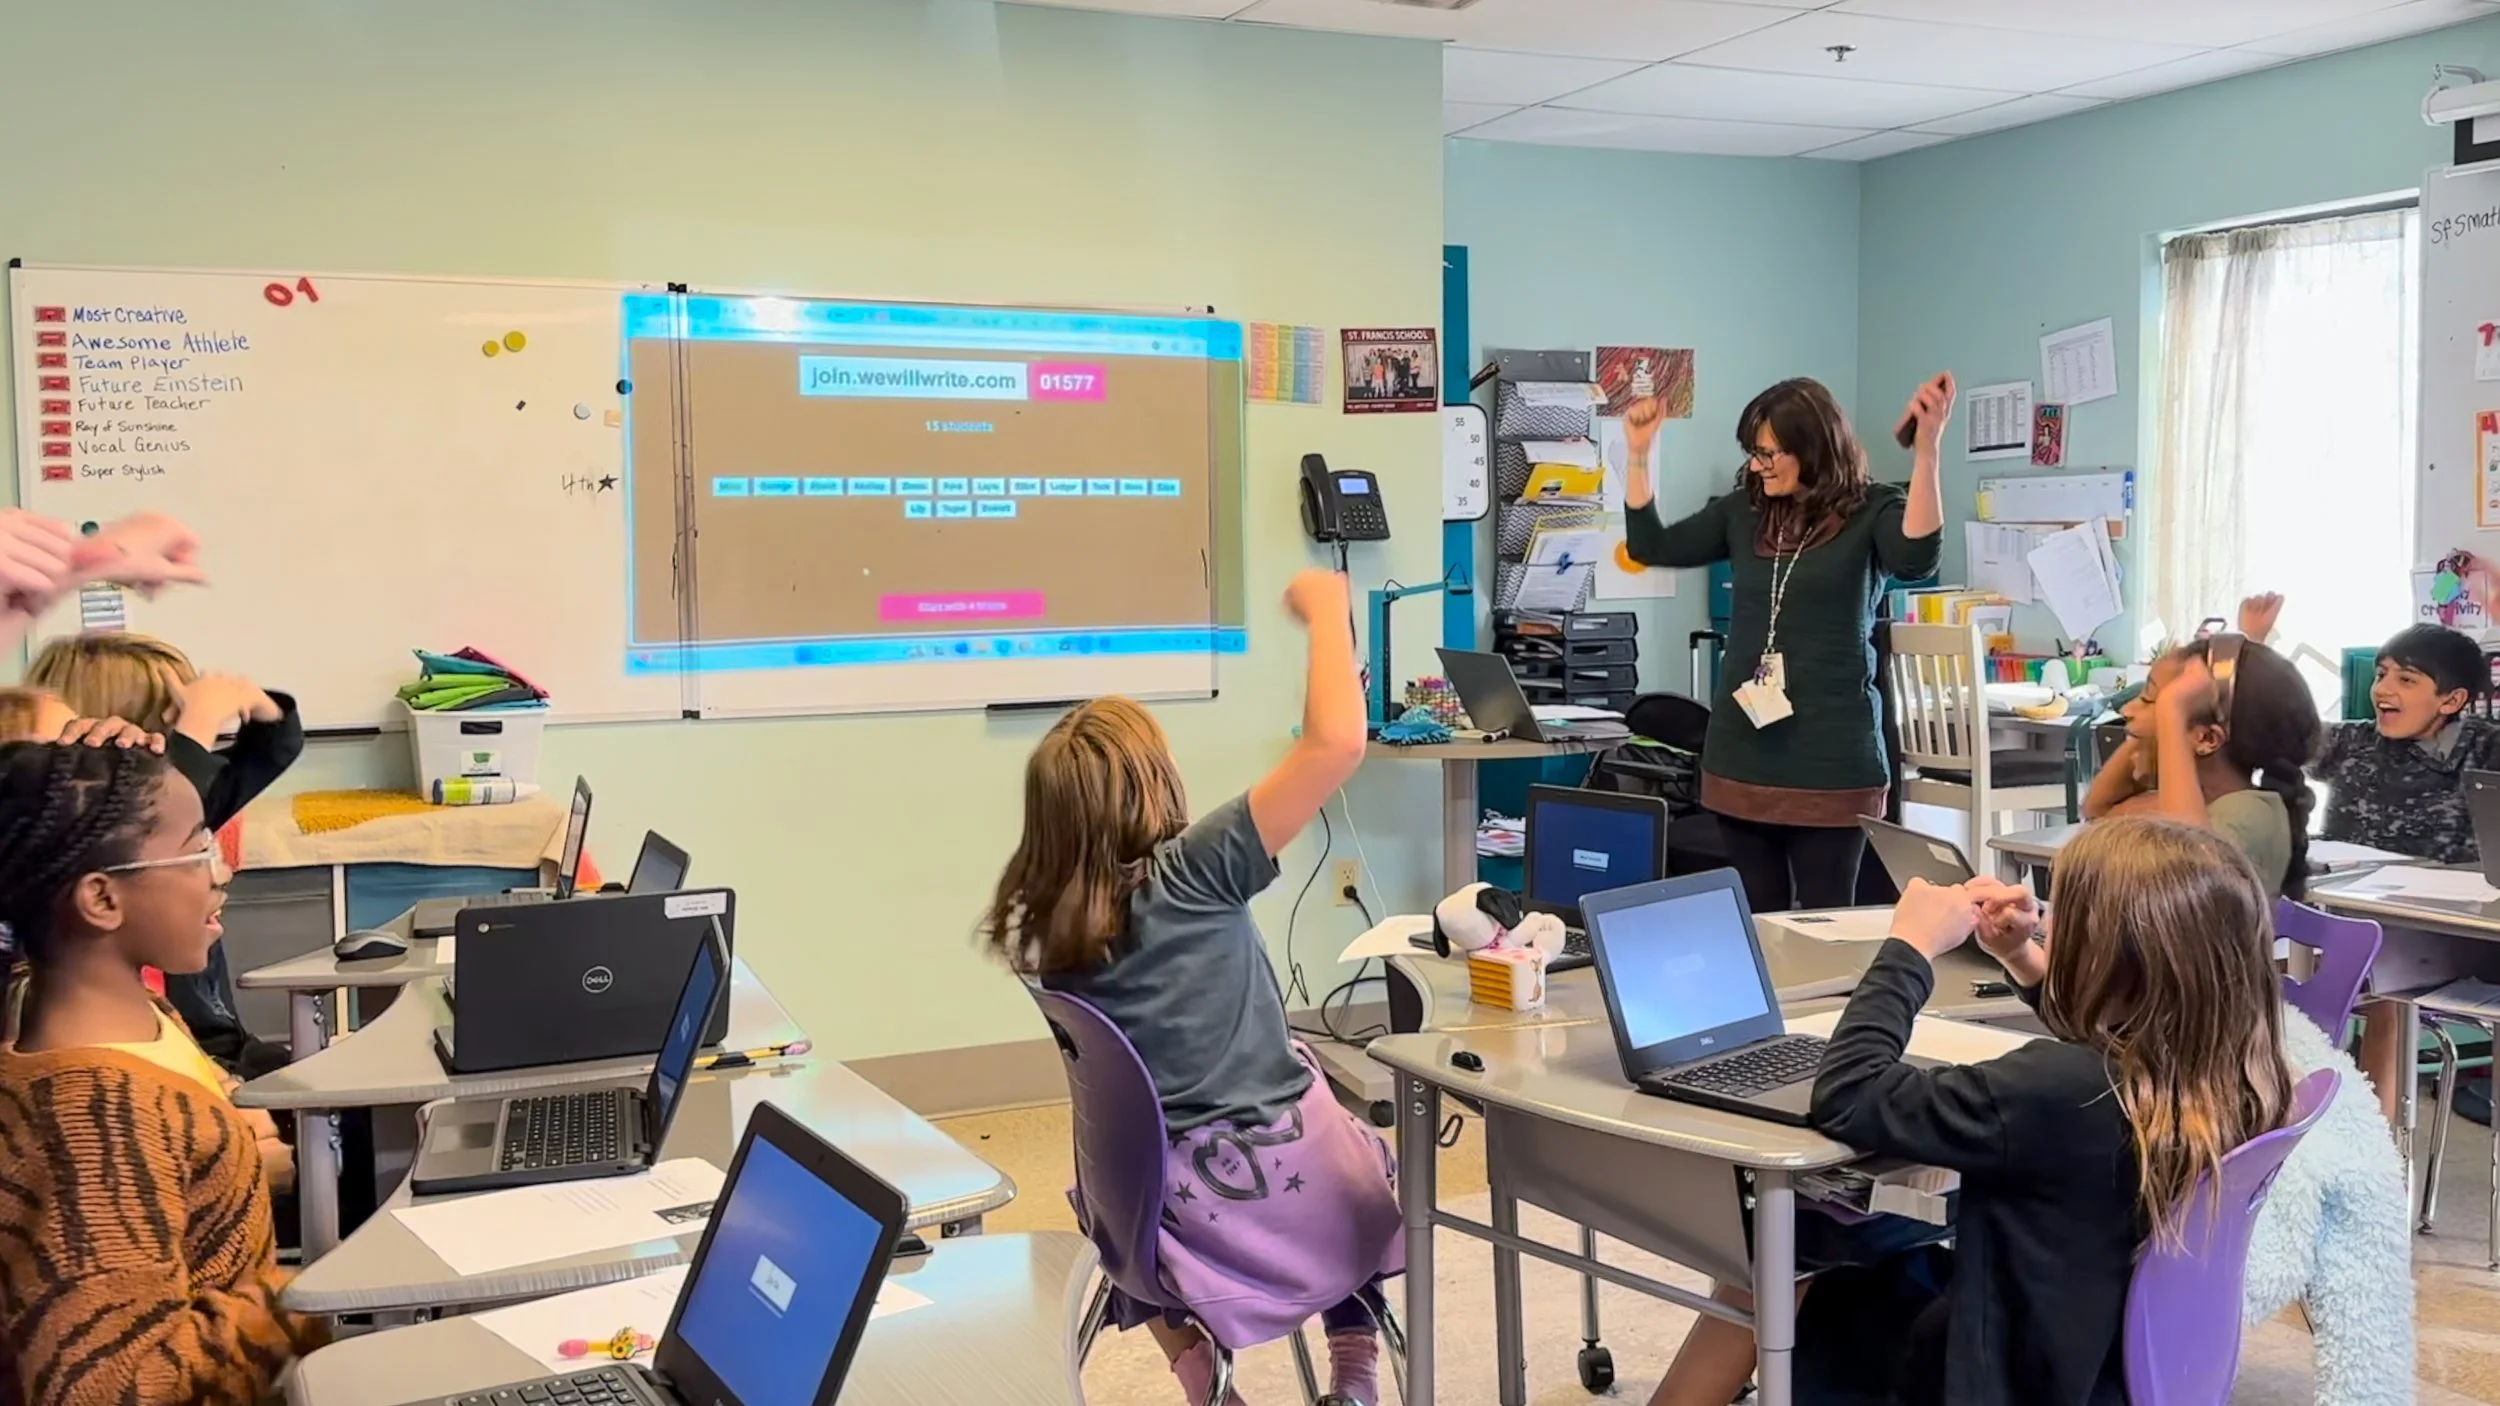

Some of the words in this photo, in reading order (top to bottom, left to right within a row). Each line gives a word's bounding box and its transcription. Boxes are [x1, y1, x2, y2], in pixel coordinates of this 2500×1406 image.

[73, 306, 111, 322] Most
[115, 305, 187, 324] Creative
[72, 333, 171, 350] Awesome
[183, 330, 250, 354] Athlete
[1348, 331, 1360, 340] ST.
[1362, 330, 1394, 340] FRANCIS
[1395, 330, 1428, 340] SCHOOL
[74, 355, 123, 370] Team
[130, 356, 190, 375] Player
[79, 376, 143, 393] Future
[153, 374, 243, 393] Einstein
[811, 366, 1016, 390] join.wewillwrite.com
[1040, 374, 1095, 390] 01577
[78, 397, 134, 412] Future
[144, 396, 211, 411] Teacher
[76, 420, 98, 436] Ray
[102, 420, 112, 431] of
[118, 421, 178, 432] Sunshine
[1455, 417, 1465, 427] 55
[78, 437, 125, 454] Vocal
[135, 436, 190, 452] Genius
[1470, 434, 1480, 444] 50
[1474, 456, 1485, 466] 45
[81, 464, 114, 479] Super
[121, 464, 165, 482] Stylish
[1469, 479, 1480, 488] 40
[1457, 496, 1468, 506] 35
[586, 975, 609, 985] DELL
